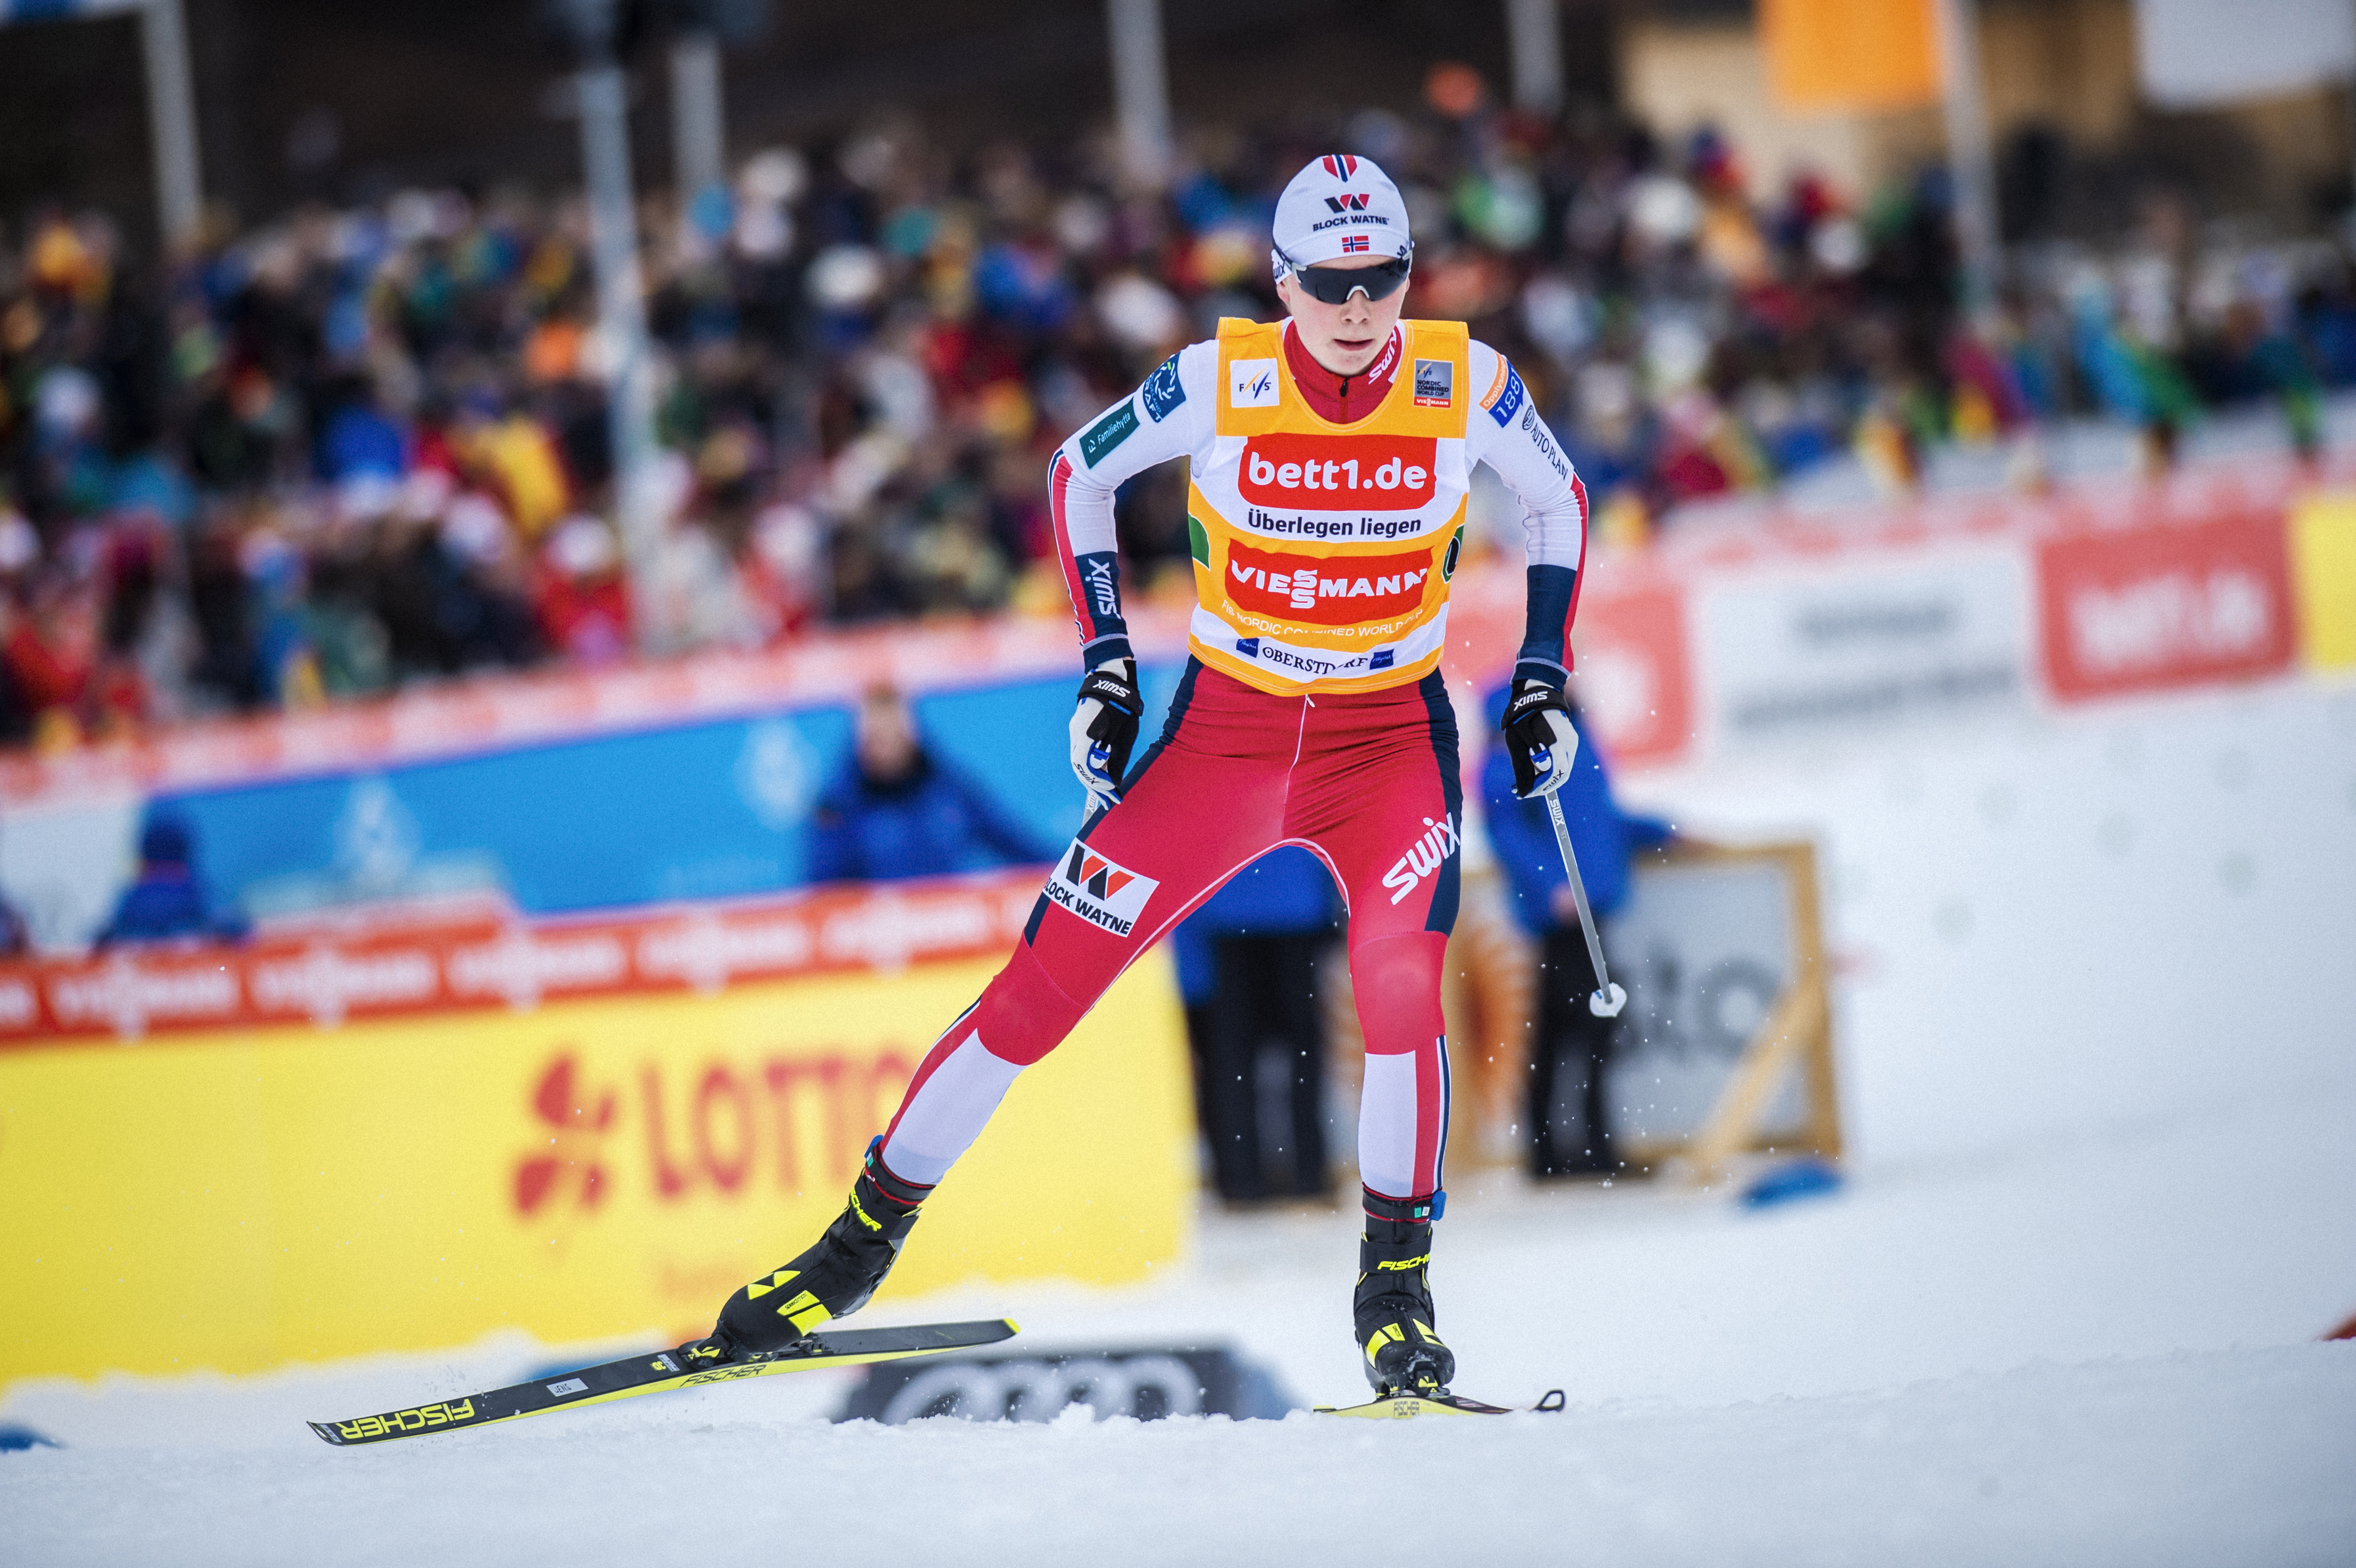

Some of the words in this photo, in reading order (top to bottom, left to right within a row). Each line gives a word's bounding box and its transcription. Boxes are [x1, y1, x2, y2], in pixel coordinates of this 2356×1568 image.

[1313, 216, 1348, 231] BLOCK
[1351, 215, 1388, 225] WATNE
[1239, 382, 1272, 392] FIS
[1496, 366, 1521, 418] 1881
[1097, 412, 1131, 445] Familiehytta
[1248, 451, 1427, 490] bett1.de
[1248, 509, 1354, 537] Überlegen
[1361, 518, 1421, 537] liegen
[1231, 559, 1427, 609] VIESSMANN
[1222, 599, 1235, 616] FIS
[1237, 612, 1282, 635] NORDIC
[1358, 621, 1404, 637] WORLD
[1044, 878, 1075, 908] LOCK
[1075, 898, 1133, 935] WATNE
[1377, 1251, 1430, 1271] FISCH
[679, 1364, 767, 1387] FISCHER
[335, 1398, 475, 1440] FISCHER
